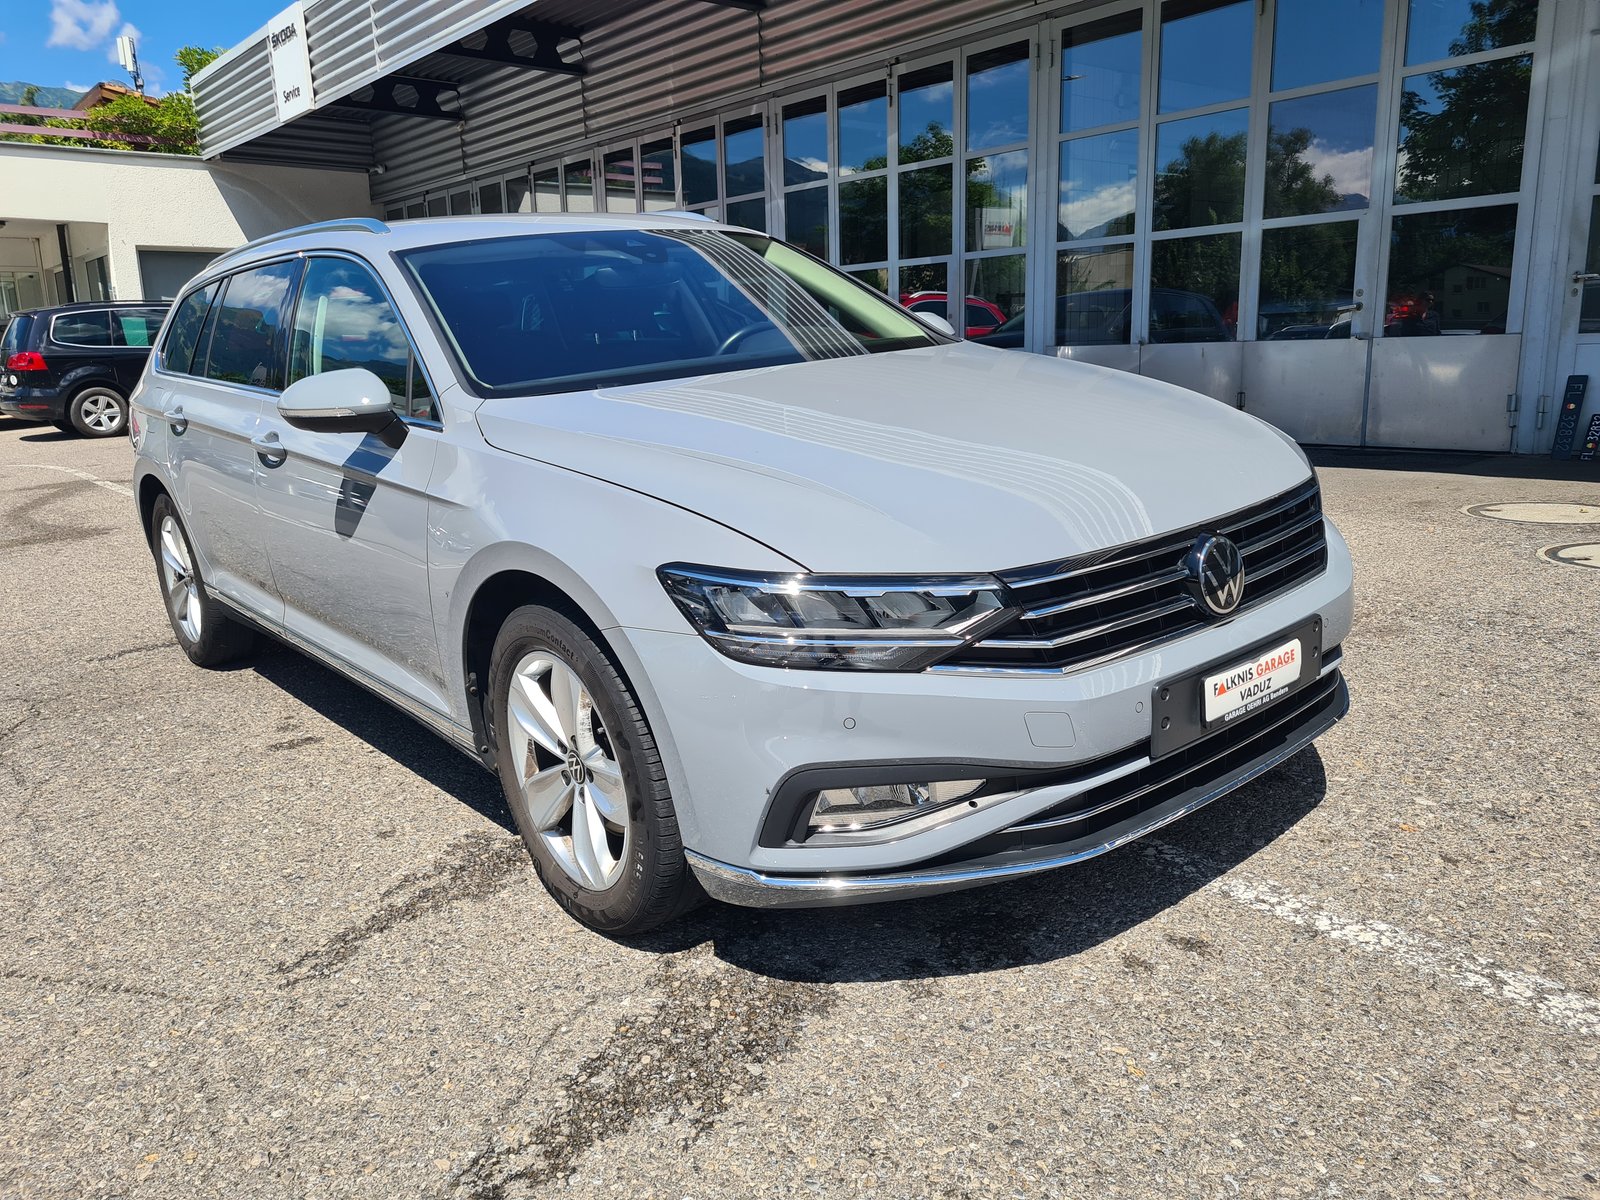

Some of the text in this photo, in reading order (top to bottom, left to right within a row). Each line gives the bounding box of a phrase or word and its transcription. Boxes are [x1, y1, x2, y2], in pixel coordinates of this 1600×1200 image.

[271, 22, 298, 49] ŠKODA
[282, 86, 301, 103] Service
[1568, 383, 1584, 398] FL
[1580, 450, 1594, 460] FL
[1256, 648, 1296, 678] GARAGE
[1239, 677, 1273, 702] VADUZ
[1224, 686, 1289, 722] GARAGE OEHRI AG Bendern
